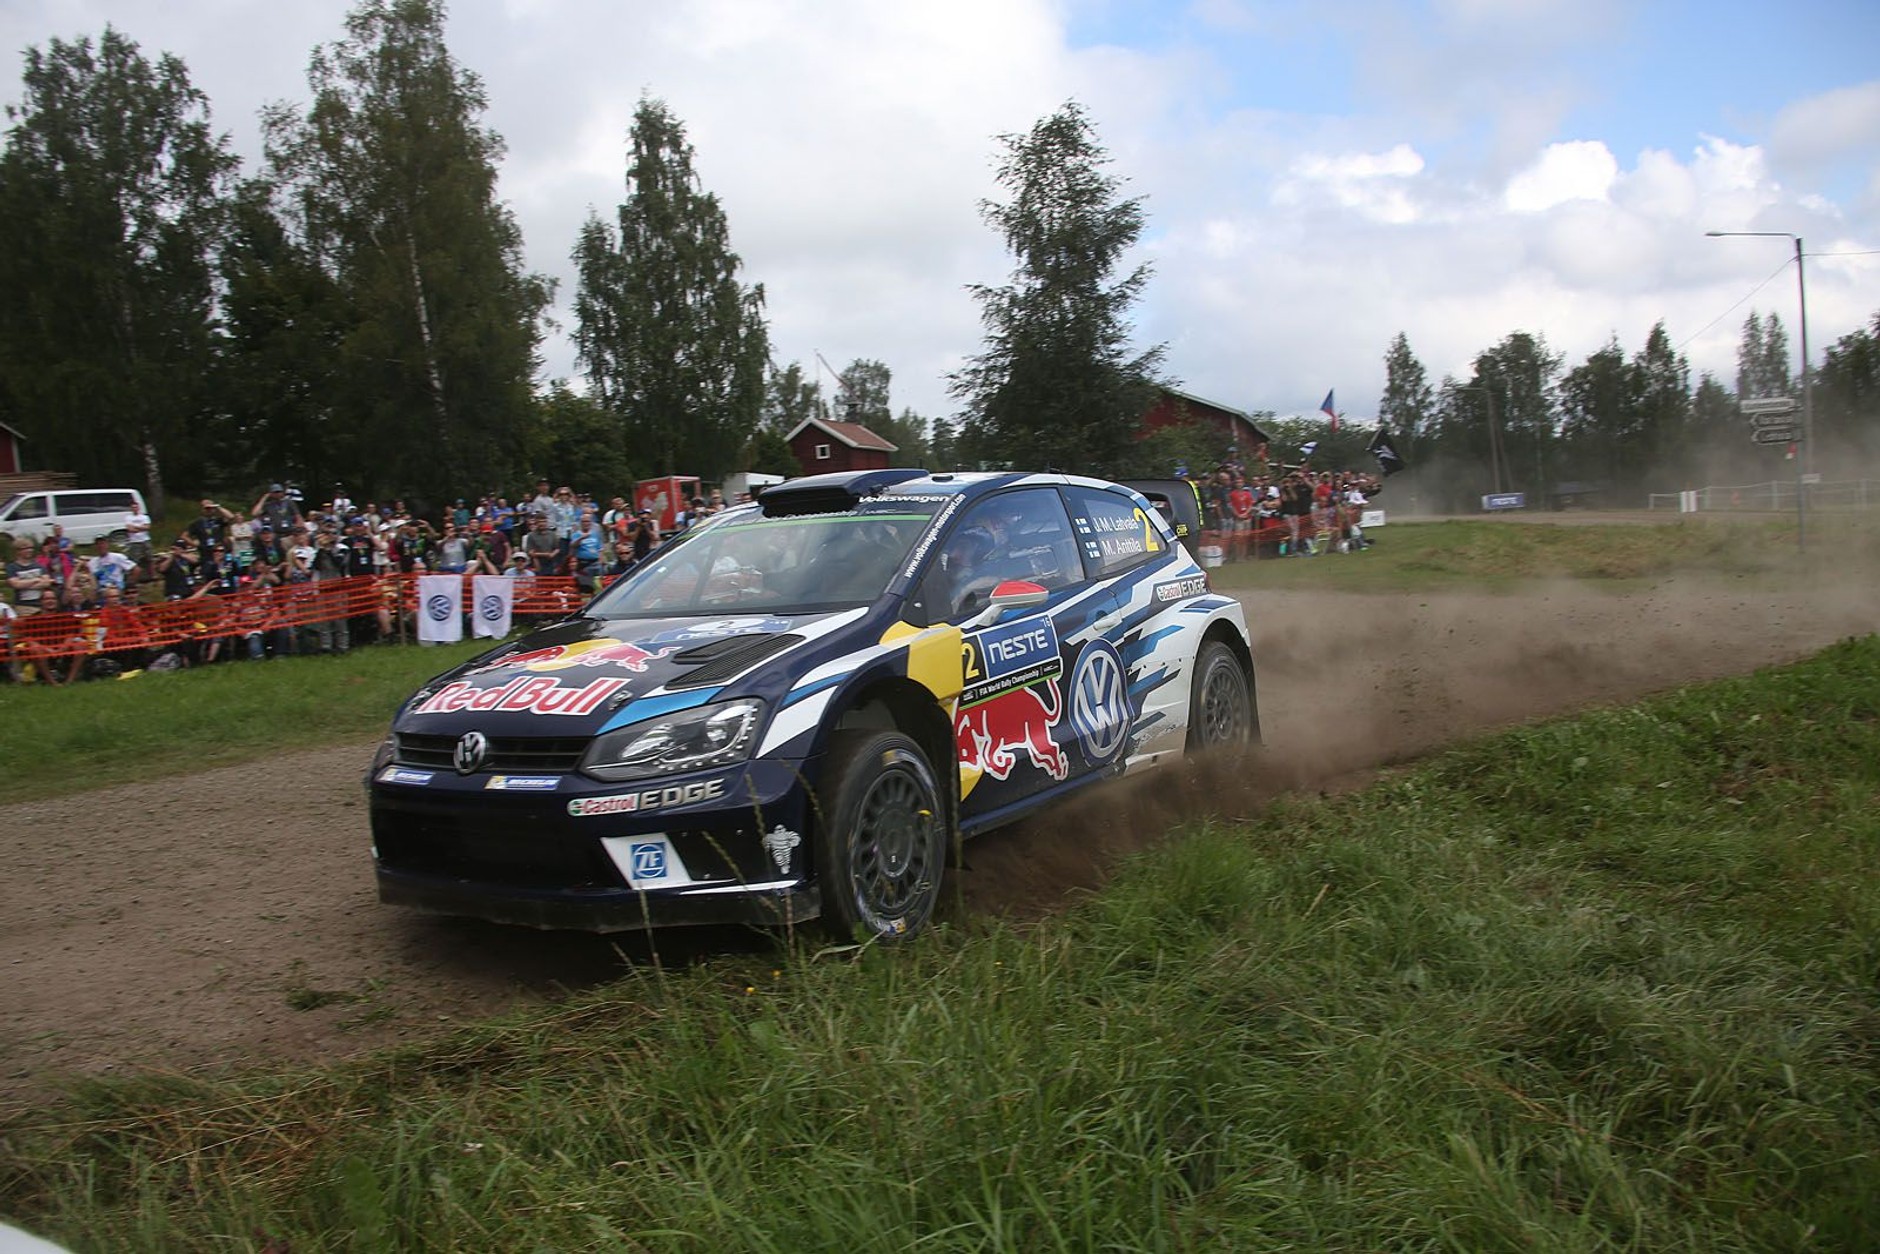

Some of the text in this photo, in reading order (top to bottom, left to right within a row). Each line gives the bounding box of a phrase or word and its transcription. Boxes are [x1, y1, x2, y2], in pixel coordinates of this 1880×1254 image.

[859, 495, 949, 503] Volkswagen
[1133, 507, 1159, 552] 2
[1181, 578, 1207, 597] EDGE
[962, 642, 979, 679] 2
[988, 629, 1048, 664] NESTE
[415, 676, 632, 716] Red Bull
[583, 778, 725, 814] Castrol EDGE
[635, 850, 663, 871] ZF
